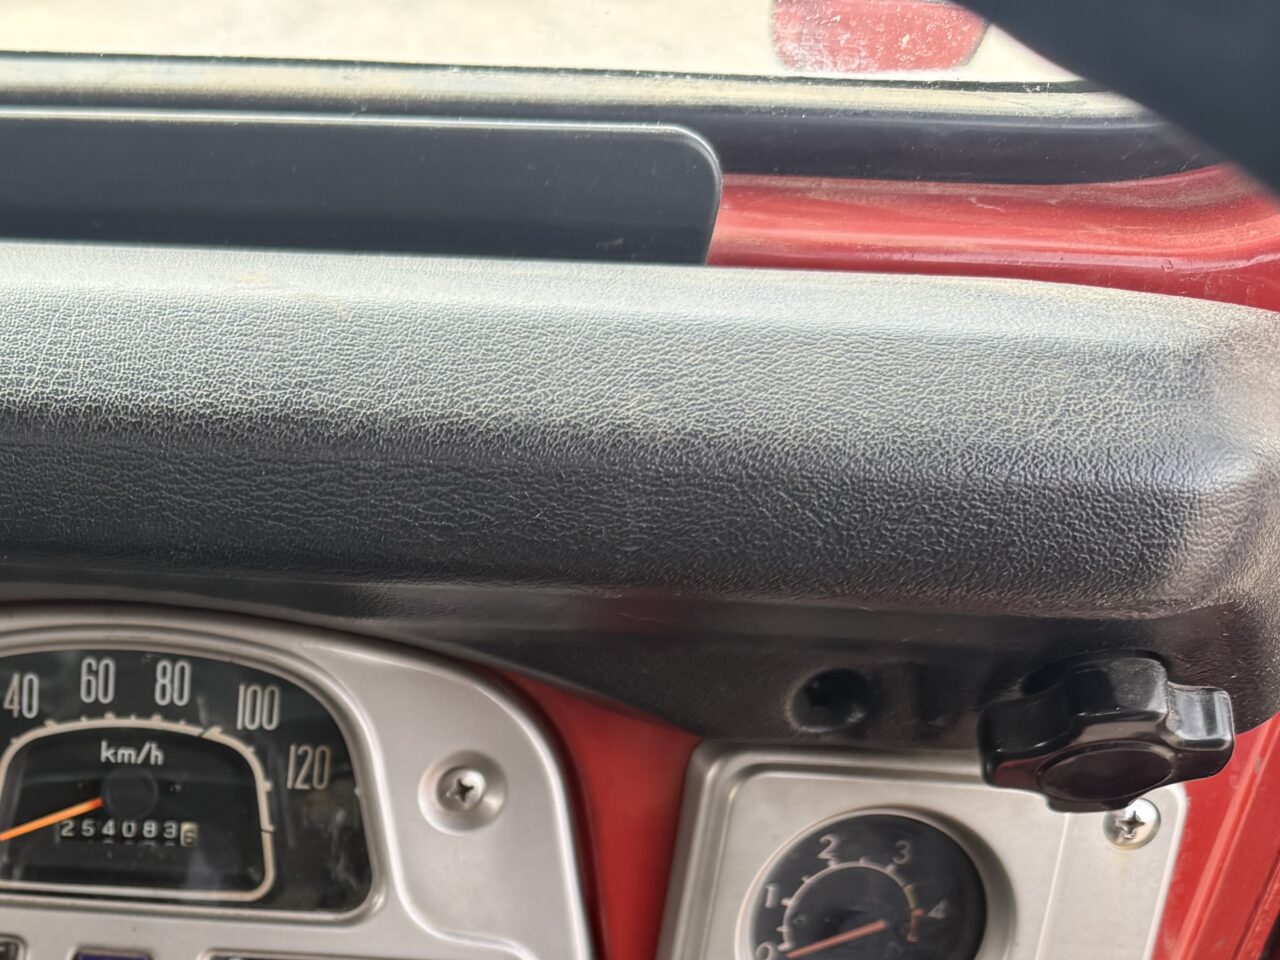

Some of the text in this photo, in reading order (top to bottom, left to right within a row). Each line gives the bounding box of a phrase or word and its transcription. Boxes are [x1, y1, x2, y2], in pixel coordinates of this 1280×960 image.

[3, 672, 39, 719] 40
[80, 657, 115, 704] 60
[154, 659, 191, 707] 80
[236, 684, 281, 731] 100
[100, 739, 165, 766] km/h
[286, 744, 331, 790] 120
[818, 833, 840, 861] 2
[893, 839, 912, 865] 3
[764, 883, 777, 909] 1
